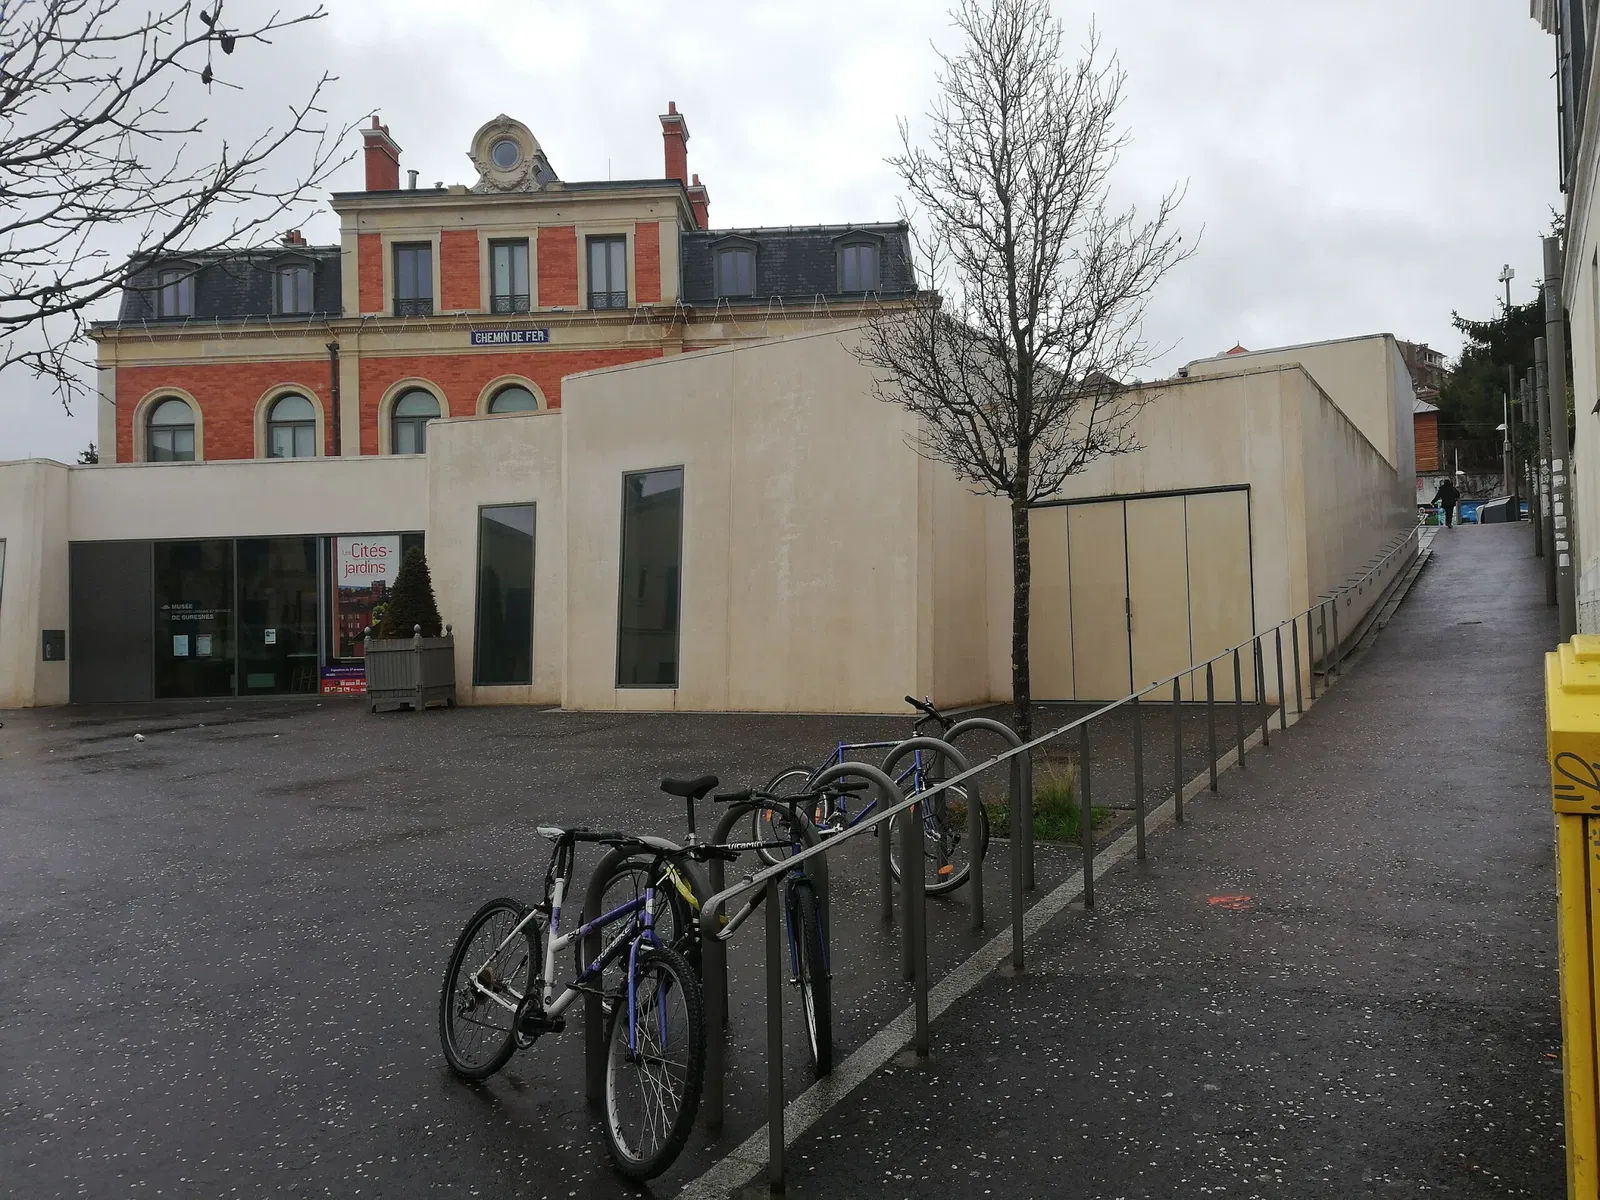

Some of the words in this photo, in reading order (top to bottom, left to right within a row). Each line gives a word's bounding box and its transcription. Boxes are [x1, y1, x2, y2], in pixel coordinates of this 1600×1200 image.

[475, 332, 510, 343] CHEMIN
[511, 331, 524, 342] DE
[526, 331, 544, 342] FER
[344, 560, 386, 579] jardins
